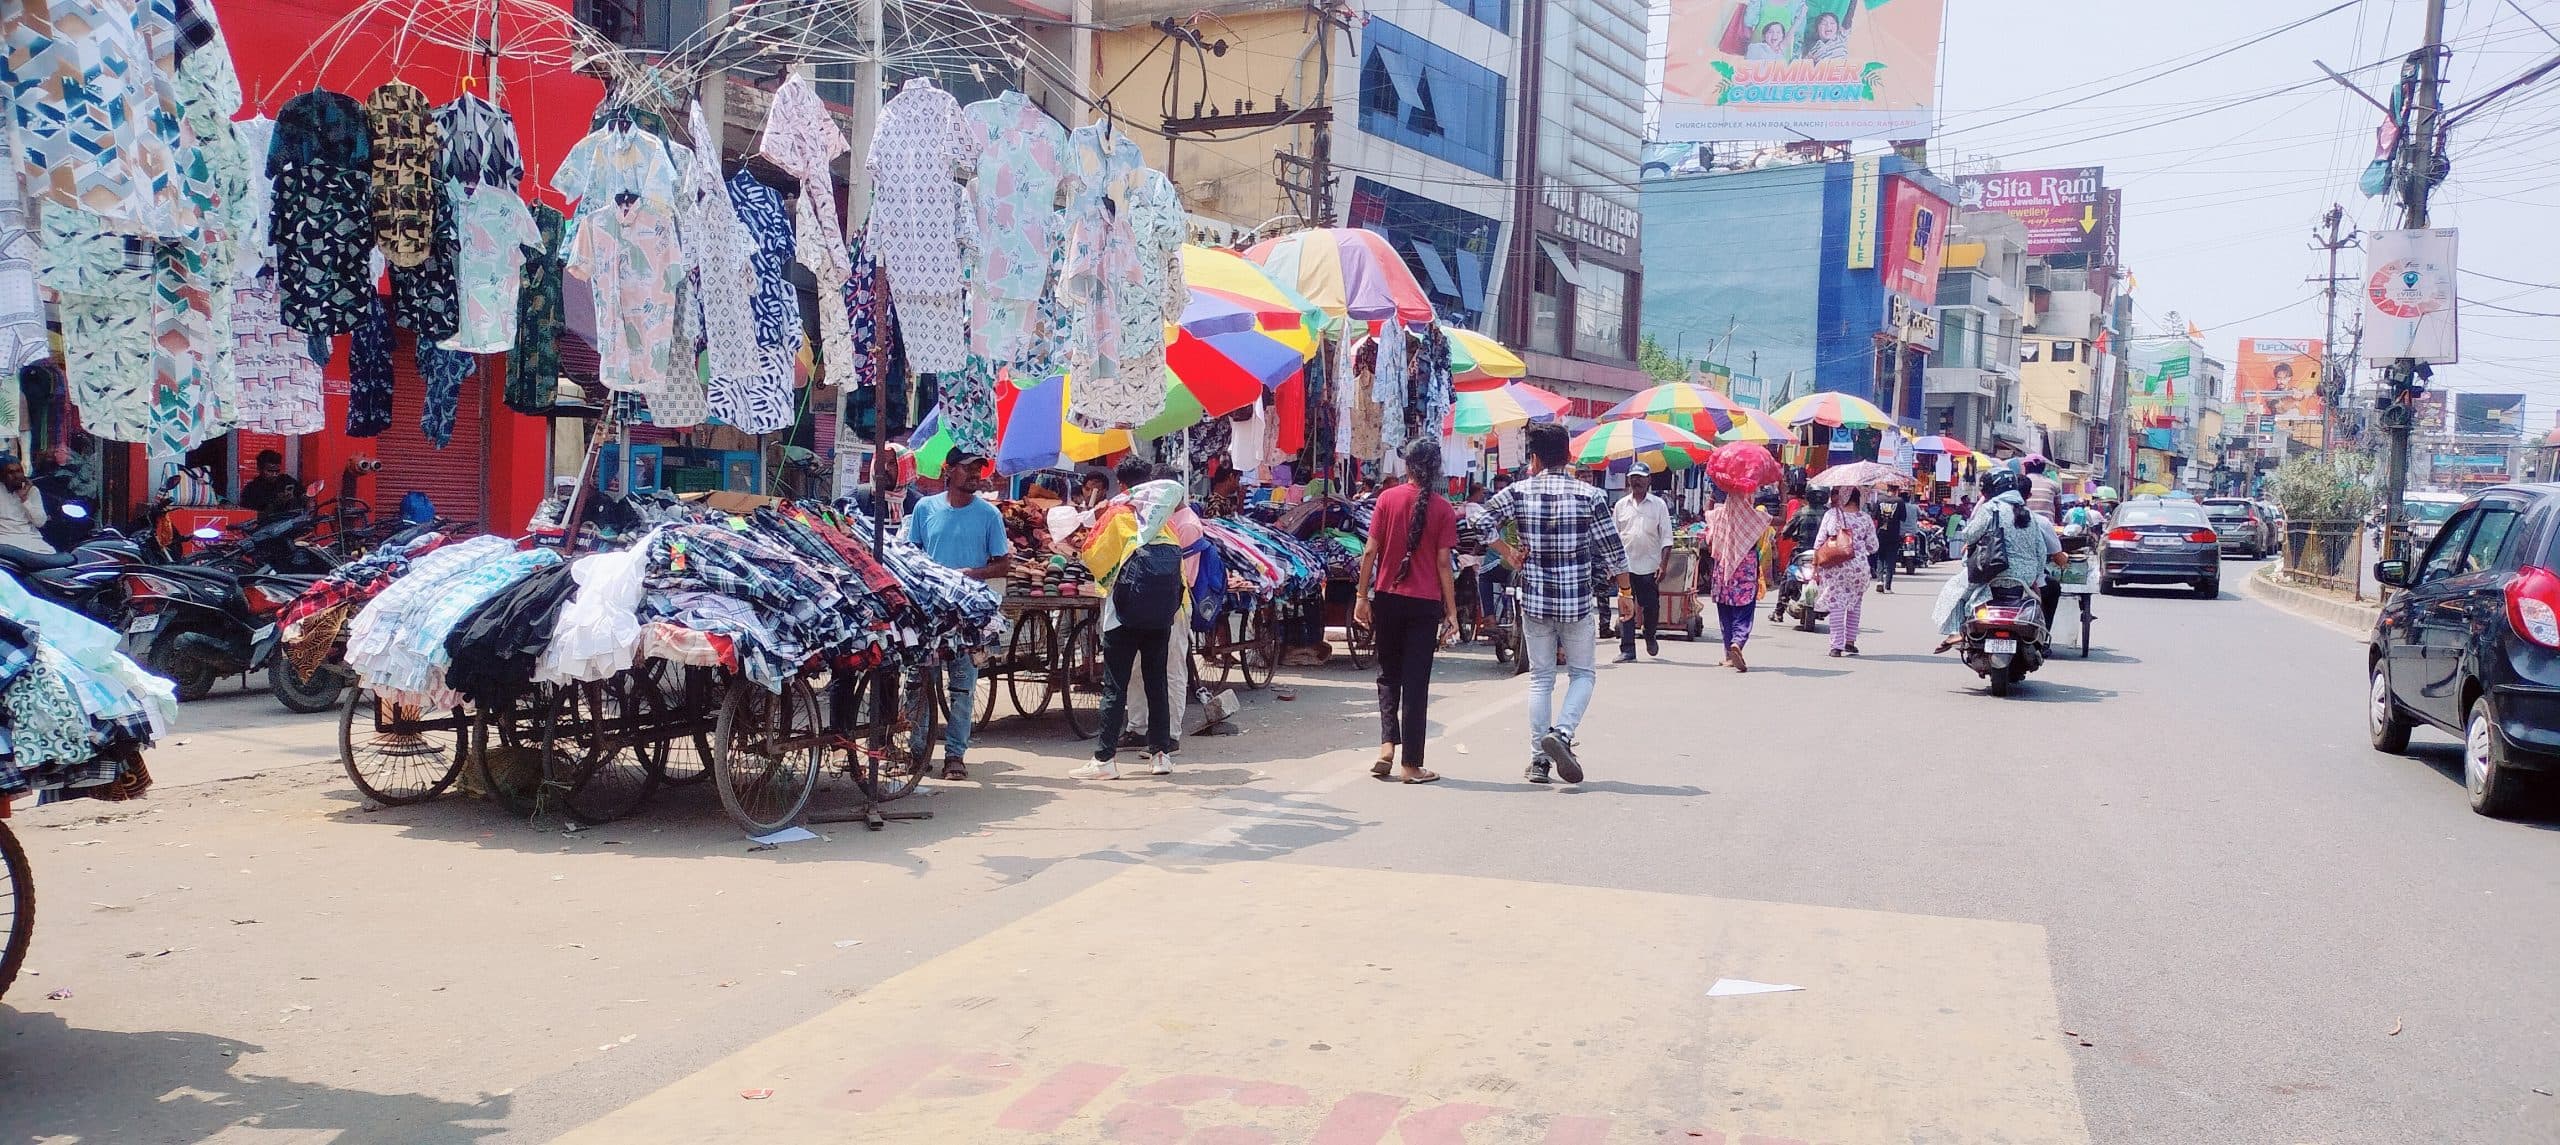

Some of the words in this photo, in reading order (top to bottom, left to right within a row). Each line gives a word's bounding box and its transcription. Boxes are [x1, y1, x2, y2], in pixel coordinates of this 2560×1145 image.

[1734, 63, 1862, 84] SUMMER
[1728, 85, 1862, 103] COLLECTION
[1986, 177, 2032, 199] Sita
[2041, 176, 2096, 206] Ram
[1986, 198, 2009, 207] Gems
[2012, 197, 2051, 206] Jewellers
[2061, 196, 2078, 204] Pvt.
[2082, 194, 2097, 203] Ltd.
[1543, 176, 1575, 214] PAUL
[1579, 191, 1638, 239] BROTHERS
[1556, 214, 1626, 256] JEWELLERS
